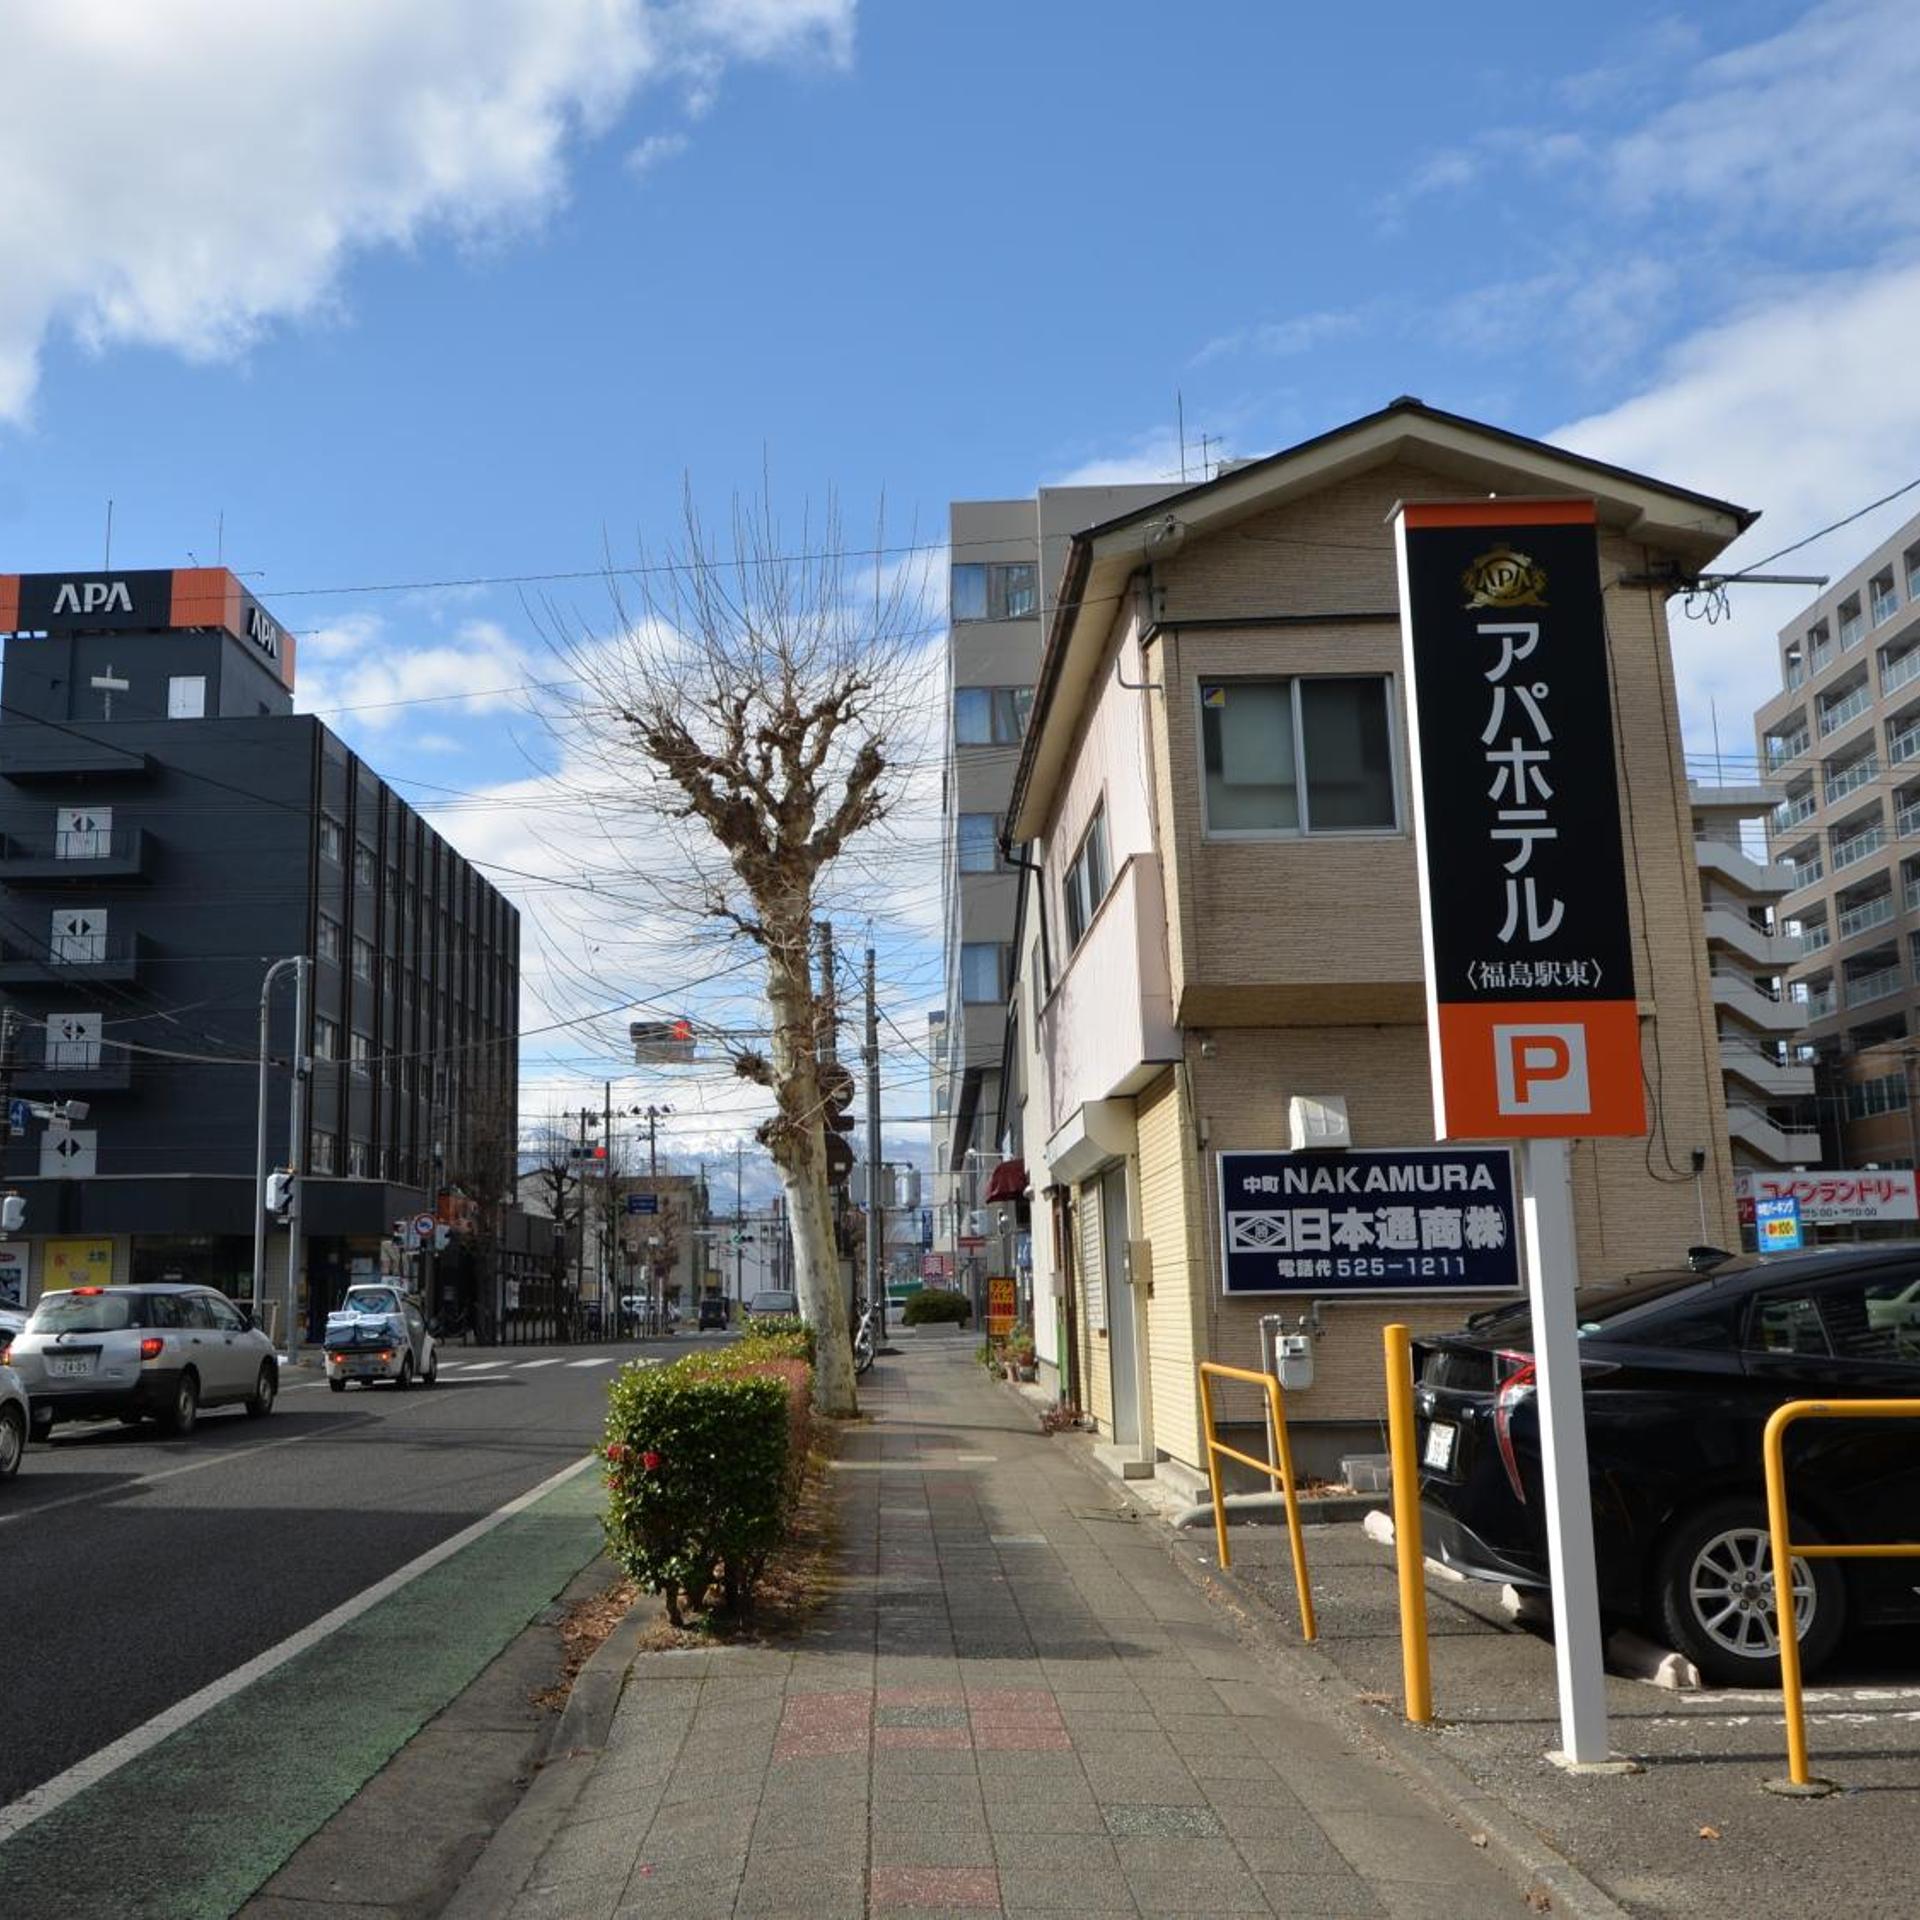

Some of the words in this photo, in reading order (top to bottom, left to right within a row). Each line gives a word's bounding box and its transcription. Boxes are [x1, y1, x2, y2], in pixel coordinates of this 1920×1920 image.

[1475, 567, 1534, 589] APA
[53, 581, 133, 614] APA
[250, 607, 278, 658] APA
[1476, 622, 1565, 943] アパホテル
[1510, 1035, 1570, 1103] P
[1243, 1175, 1279, 1193] 中町
[1284, 1164, 1496, 1194] NAKAMURA
[1337, 1256, 1466, 1276] 525-1211
